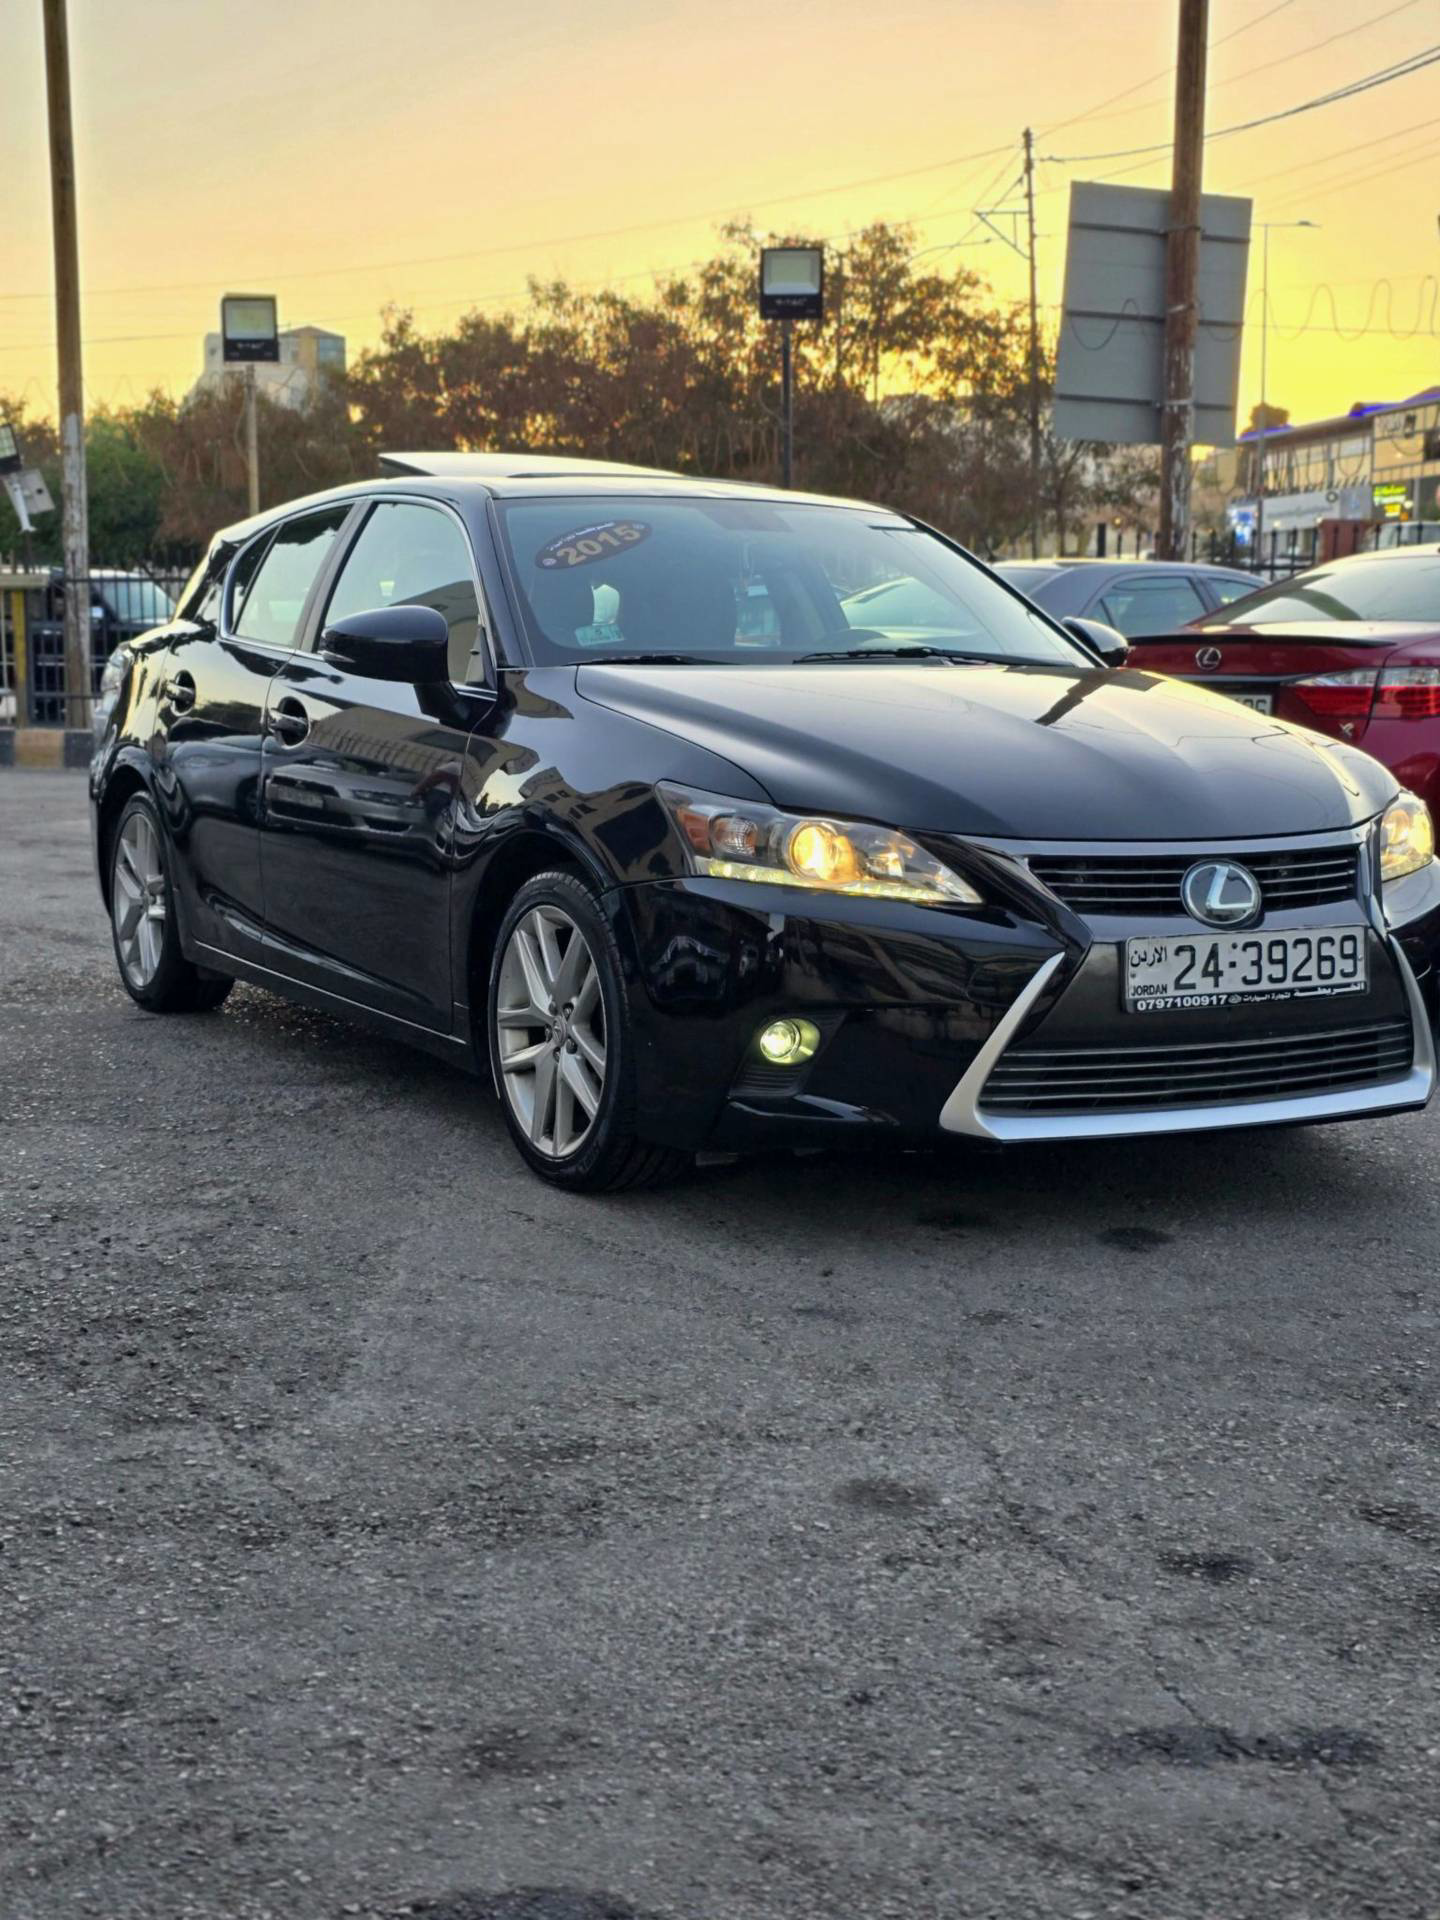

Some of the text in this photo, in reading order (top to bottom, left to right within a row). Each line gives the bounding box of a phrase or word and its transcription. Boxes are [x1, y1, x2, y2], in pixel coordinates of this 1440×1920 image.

[556, 525, 640, 565] 2015
[1131, 984, 1168, 996] JORDAN
[1137, 995, 1228, 1011] 0797100917
